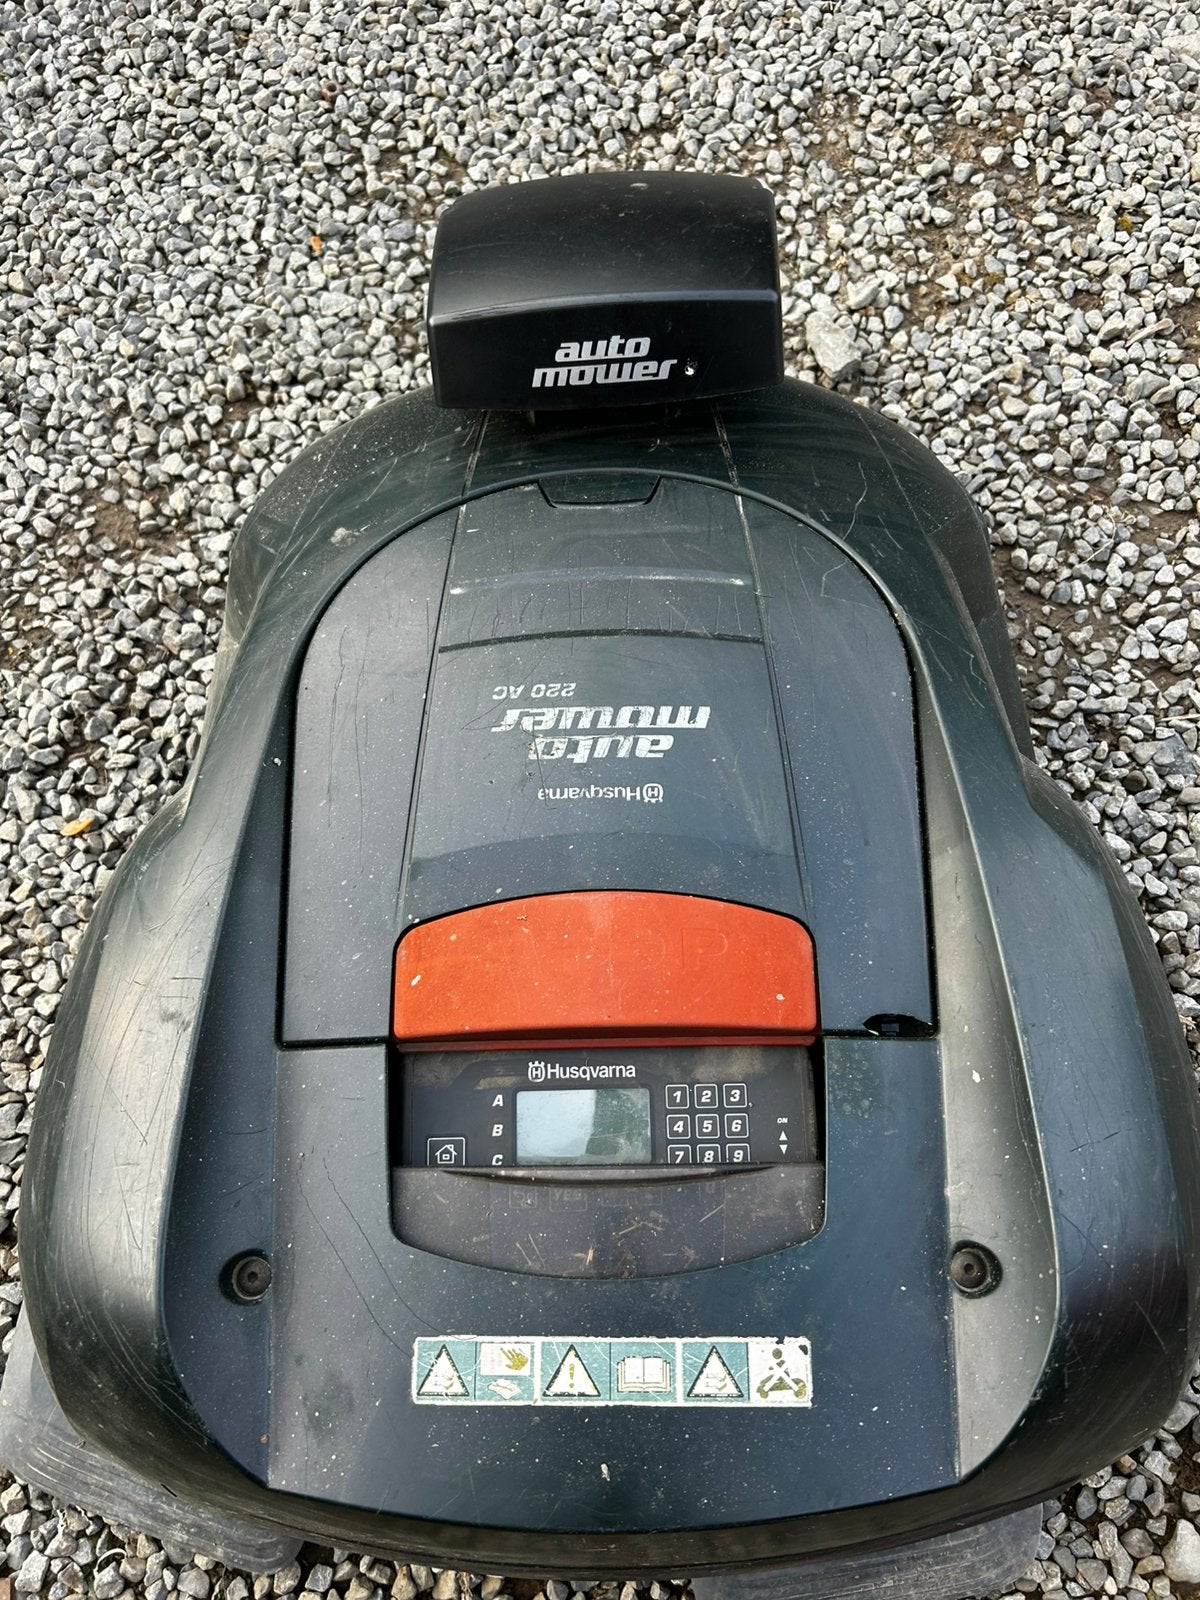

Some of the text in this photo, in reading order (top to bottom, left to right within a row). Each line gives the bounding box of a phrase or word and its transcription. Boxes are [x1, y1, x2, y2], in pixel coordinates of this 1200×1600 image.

[555, 335, 651, 362] auto
[532, 359, 677, 388] mower
[491, 682, 577, 700] 220 AC
[491, 705, 711, 732] mower
[528, 734, 674, 764] auto
[537, 784, 641, 801] Husqvarna
[547, 1063, 636, 1081] Husqvarna
[492, 1094, 504, 1107] A
[673, 1089, 741, 1103] 1 2 3
[492, 1124, 504, 1137] B
[673, 1119, 742, 1133] 4 5 6
[492, 1154, 503, 1166] C
[674, 1150, 744, 1164] 7 8 9
